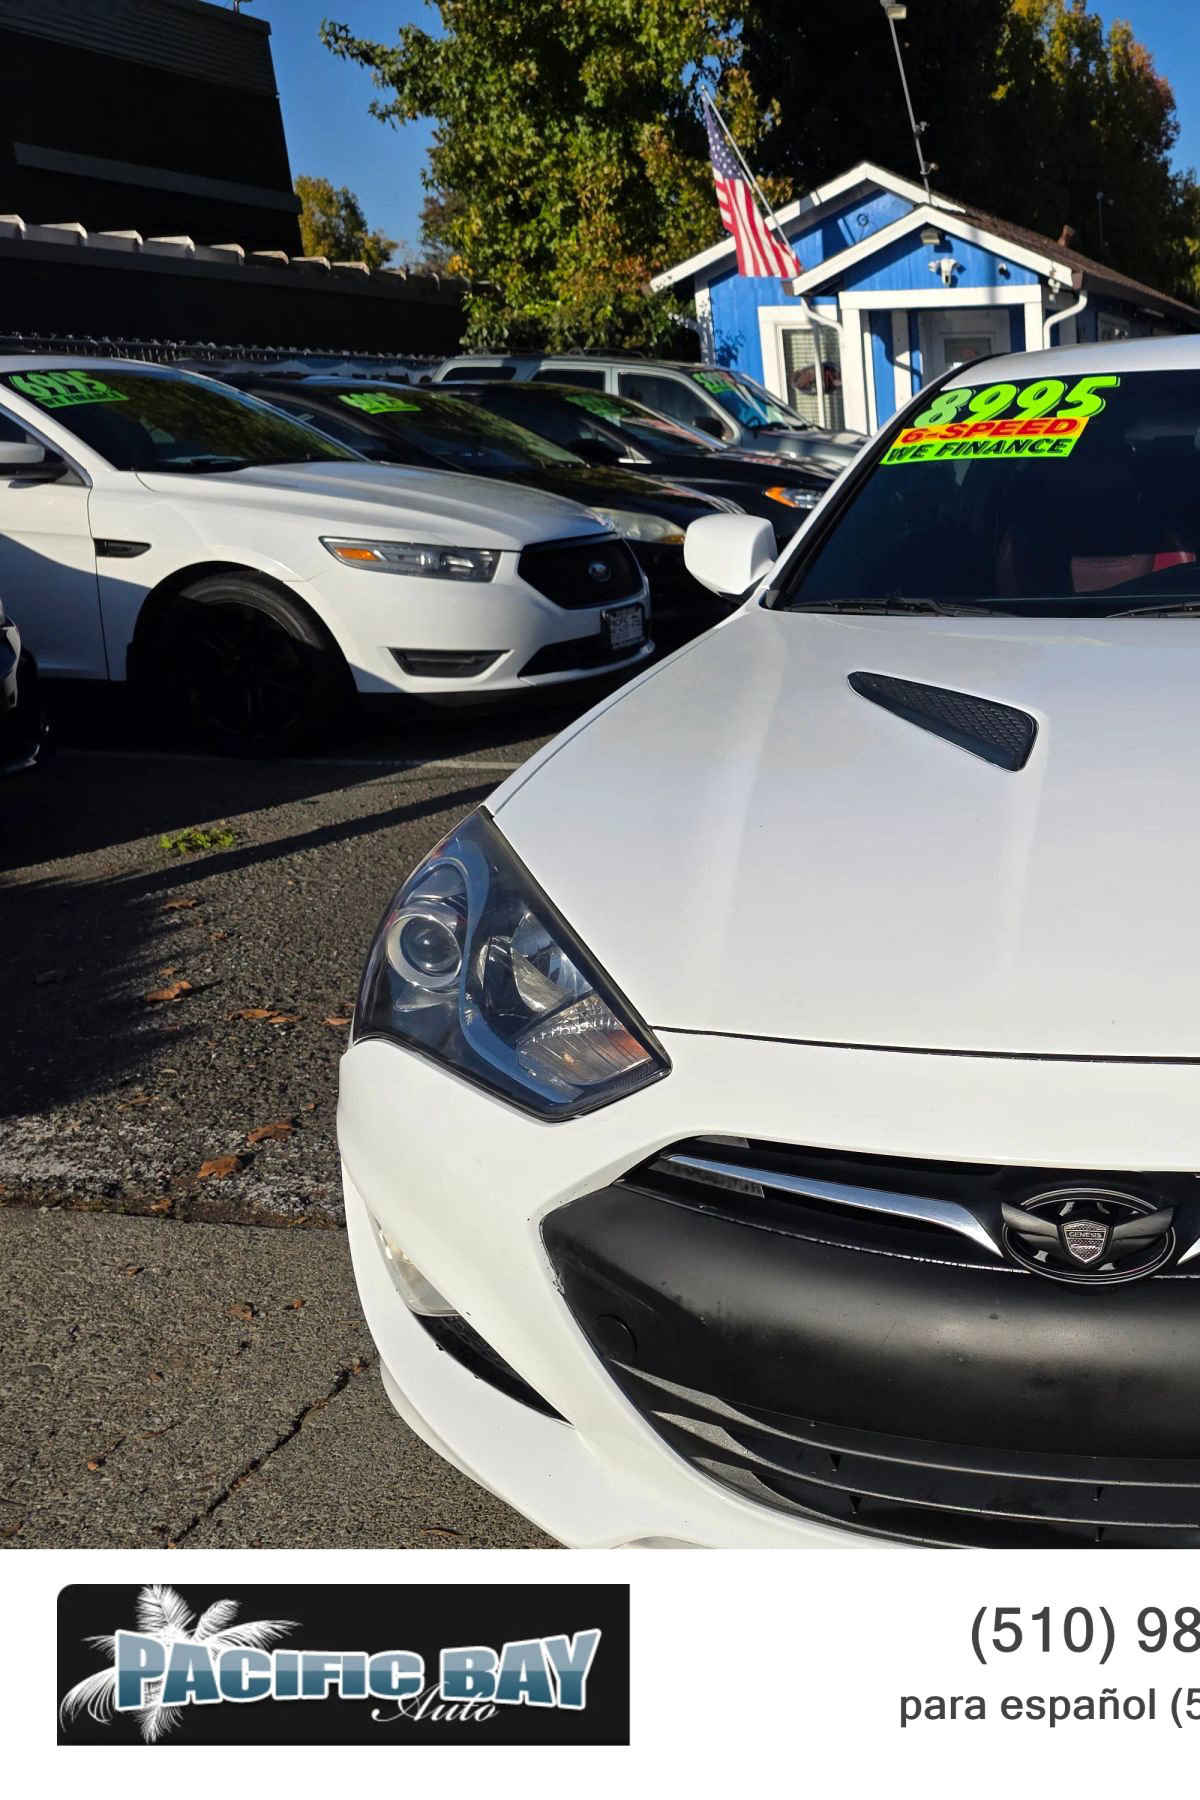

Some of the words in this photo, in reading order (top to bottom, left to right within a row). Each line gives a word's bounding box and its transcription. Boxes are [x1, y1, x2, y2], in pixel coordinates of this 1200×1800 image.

[8, 370, 111, 399] 6995
[914, 375, 1120, 428] 8995
[901, 418, 1081, 444] 6-SPEED
[886, 443, 935, 463] WE
[934, 438, 1073, 458] FINANCE
[1069, 1231, 1102, 1239] GENESIS
